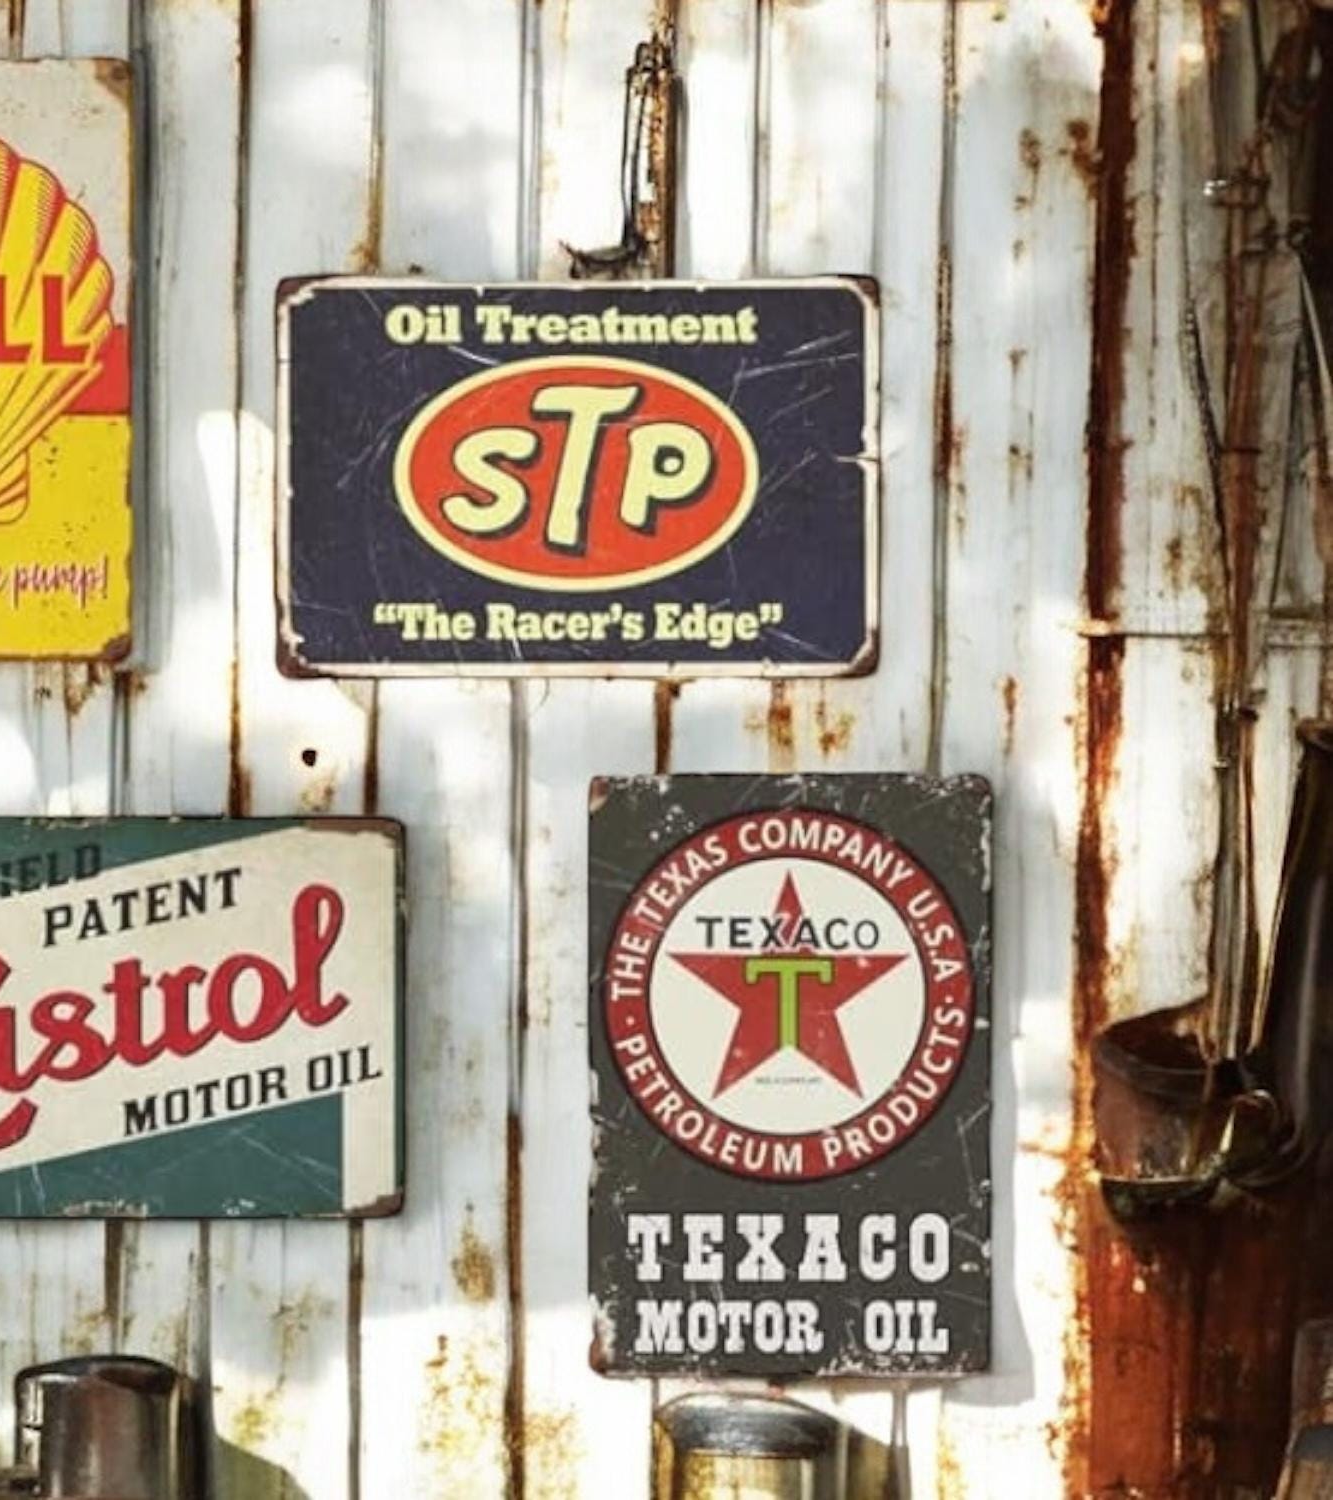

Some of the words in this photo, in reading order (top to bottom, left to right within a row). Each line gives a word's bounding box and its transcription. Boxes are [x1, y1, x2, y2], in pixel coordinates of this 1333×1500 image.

[385, 304, 462, 345] Oil
[475, 304, 758, 345] Treatment
[441, 384, 716, 556] STP
[12, 555, 109, 611] pump!
[43, 868, 243, 949] PATENT
[611, 932, 652, 1001] THE
[634, 835, 729, 923] TEXAS
[738, 818, 915, 889] COMPANY
[695, 915, 880, 950] TEXACO
[745, 956, 834, 1048] T
[123, 1065, 288, 1138] MOTOR
[307, 1045, 384, 1094] OIL
[614, 1032, 804, 1174] PETROLEUM
[822, 1005, 966, 1169] PRODUCTS
[627, 1212, 951, 1283] TEXACO
[634, 1300, 825, 1355] MOTOR
[864, 1301, 950, 1355] OIL
